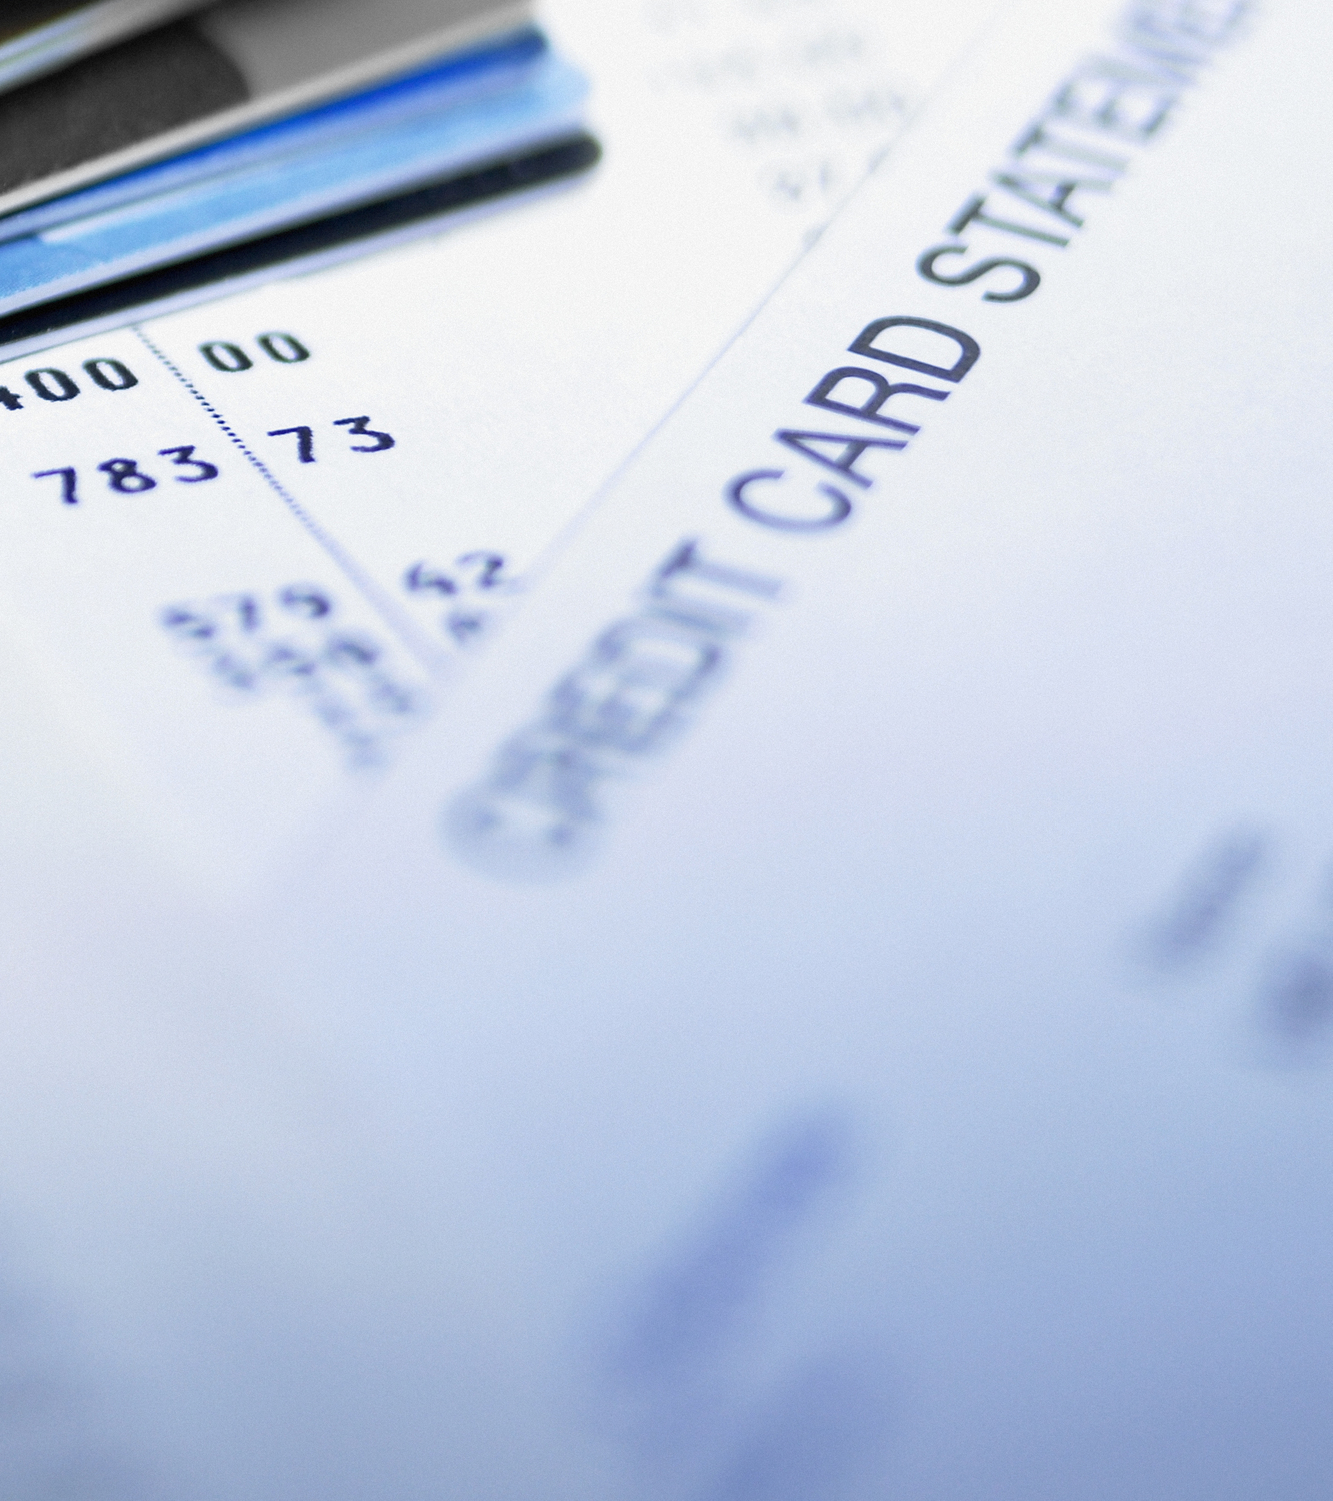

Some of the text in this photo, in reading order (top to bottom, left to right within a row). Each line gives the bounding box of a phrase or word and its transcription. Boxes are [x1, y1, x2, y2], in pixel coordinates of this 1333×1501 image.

[198, 330, 312, 374] 00
[30, 415, 397, 506] 783 73
[724, 313, 982, 536] CARD
